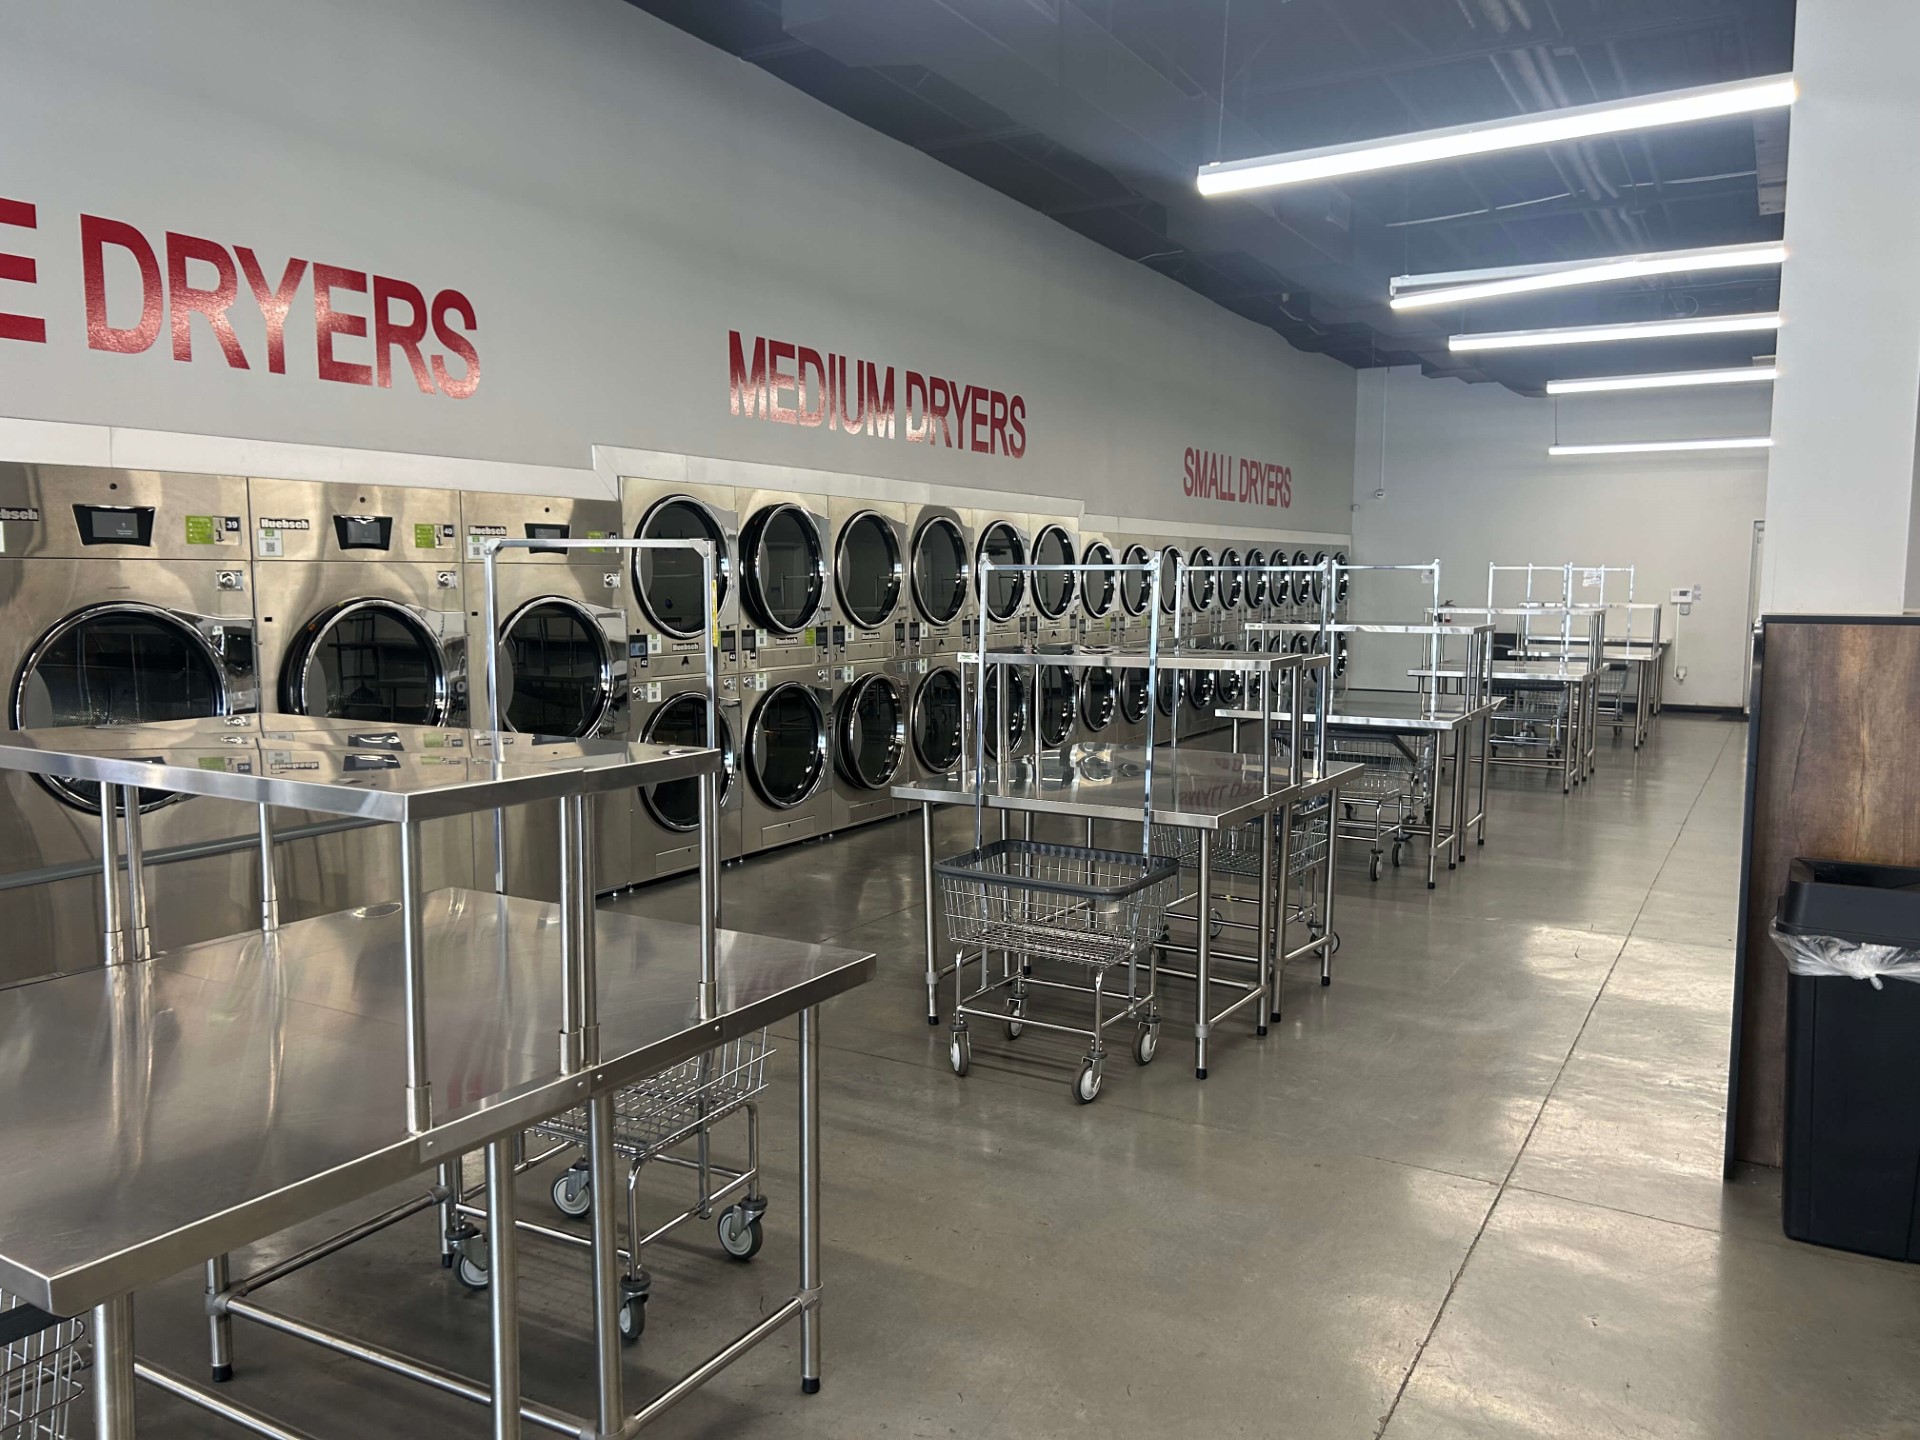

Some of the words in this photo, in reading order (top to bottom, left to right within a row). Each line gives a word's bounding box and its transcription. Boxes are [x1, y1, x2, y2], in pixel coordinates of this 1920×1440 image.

[80, 213, 481, 400] DRYERS
[728, 329, 896, 440] MEDIUM
[905, 370, 1027, 460] DRYERS
[1183, 446, 1236, 502] SMALL
[1239, 457, 1292, 509] DRYERS
[0, 508, 38, 520] bsch
[226, 520, 238, 529] 39
[261, 518, 309, 529] Huebsch
[469, 526, 506, 535] Huebsch
